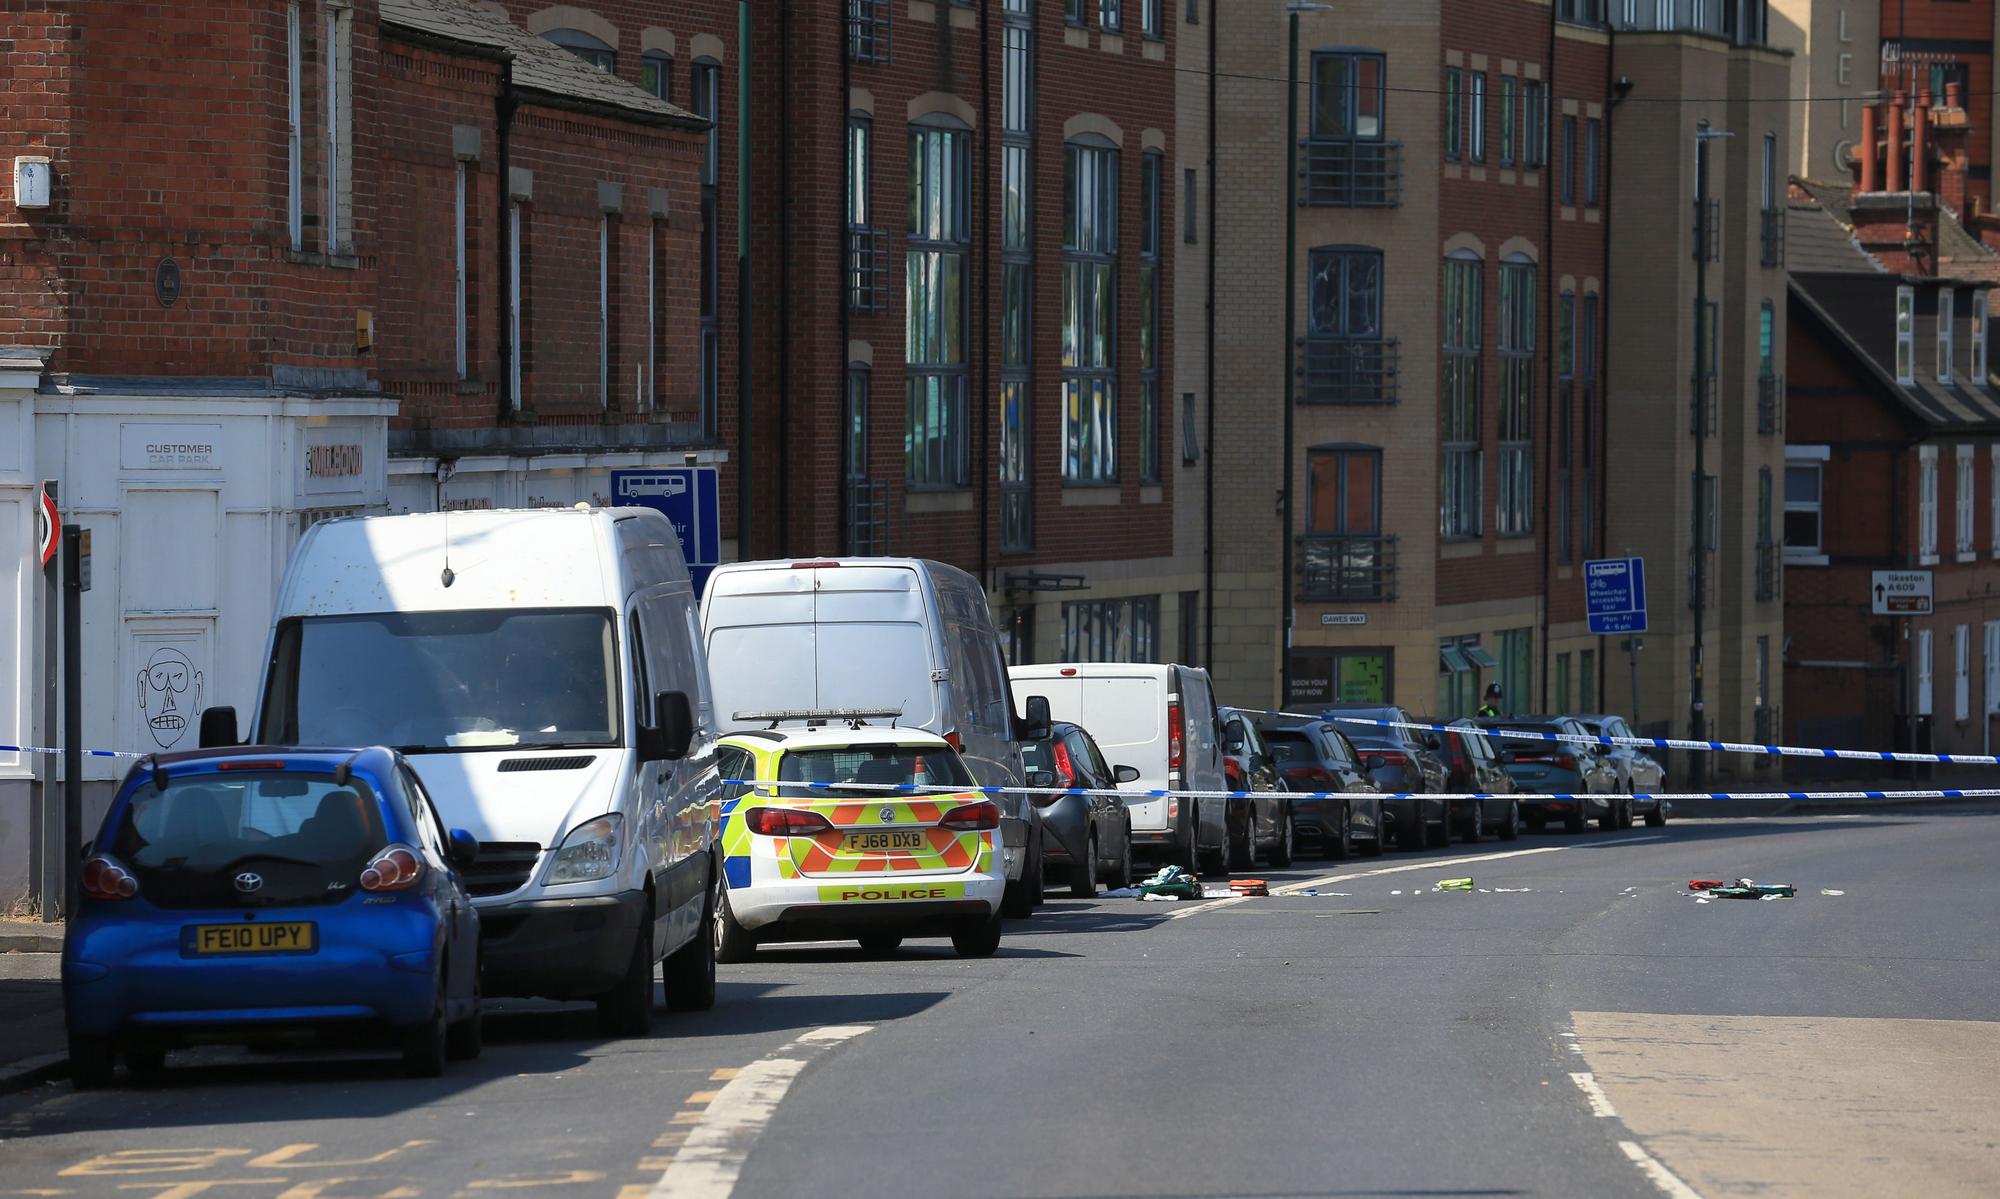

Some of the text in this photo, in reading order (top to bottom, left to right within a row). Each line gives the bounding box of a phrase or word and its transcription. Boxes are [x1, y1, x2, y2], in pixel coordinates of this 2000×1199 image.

[146, 444, 212, 454] CUSTOMER
[150, 454, 210, 464] CAR PARK
[1323, 615, 1348, 623] DAWES
[850, 831, 921, 849] FJ68 DXB
[842, 888, 946, 901] POLICE
[204, 925, 301, 949] FE10 UPY
